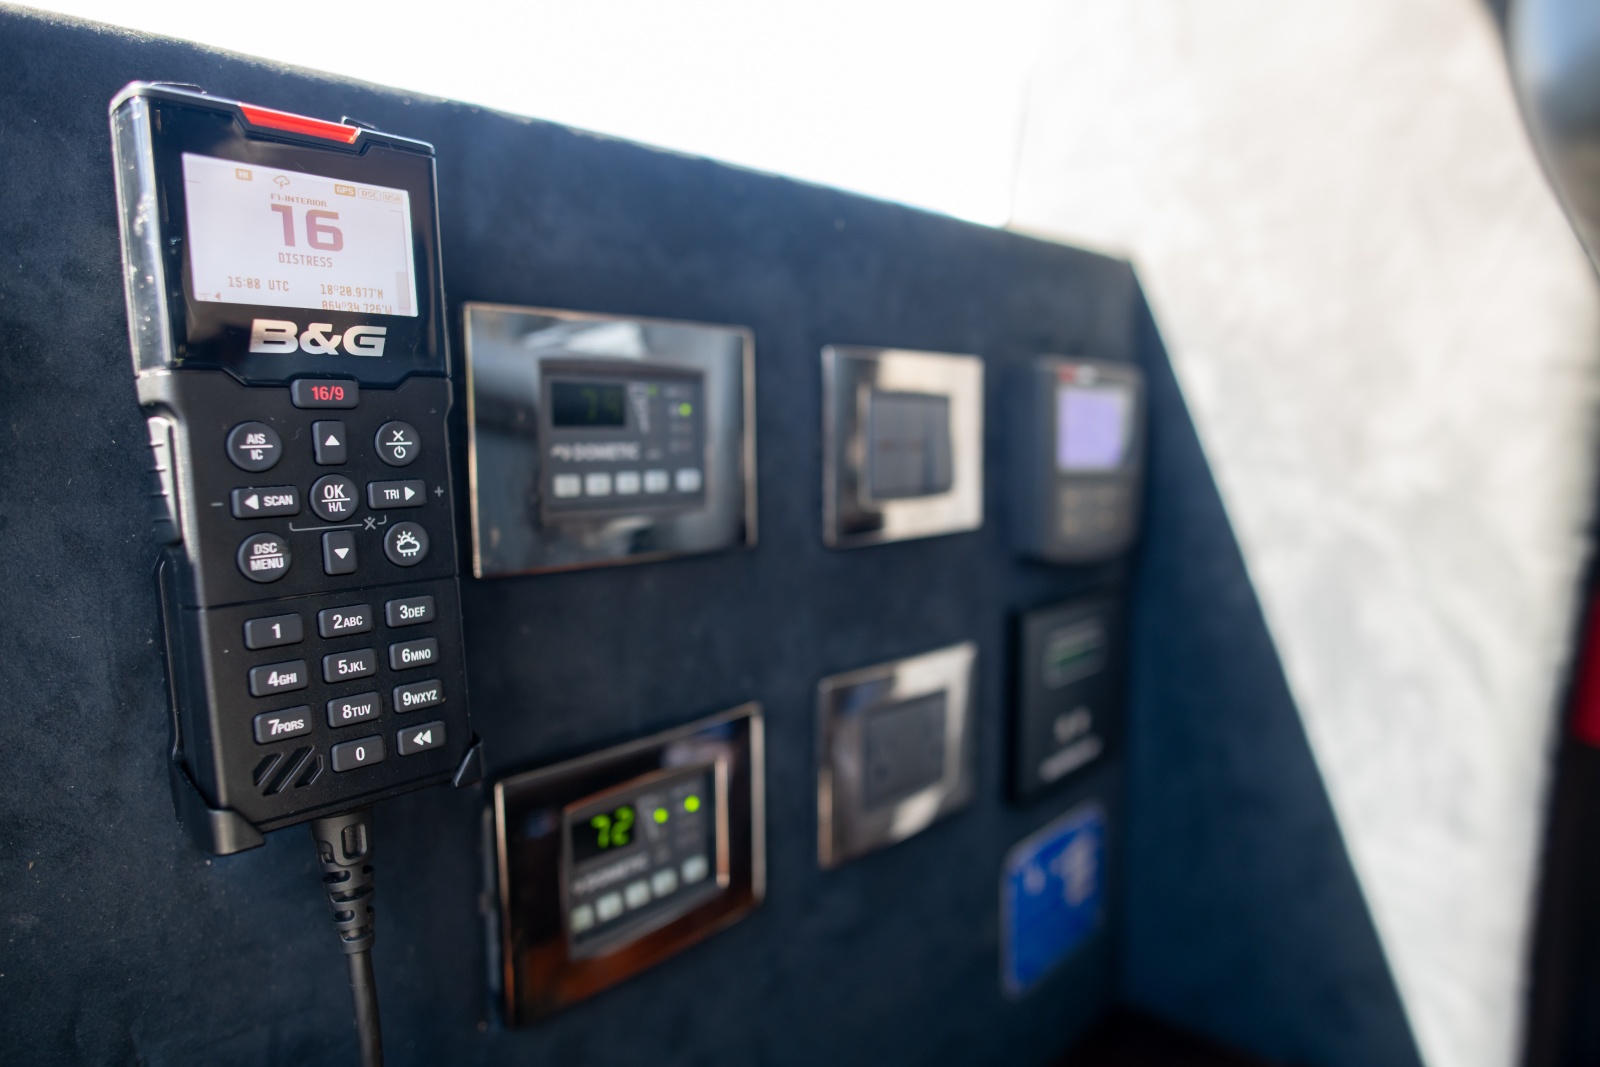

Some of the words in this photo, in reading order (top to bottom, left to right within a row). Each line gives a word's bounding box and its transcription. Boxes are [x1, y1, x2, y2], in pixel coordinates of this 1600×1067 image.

[238, 171, 249, 179] HI
[336, 186, 354, 195] GPS
[361, 190, 378, 198] DSC
[270, 193, 327, 208] F1-INTERIOR
[270, 203, 344, 252] 16
[278, 252, 333, 268] DISTRESS
[268, 279, 290, 292] UTC
[321, 300, 393, 315] 064°34726'W
[249, 318, 387, 357] B&G
[311, 386, 344, 401] 16/9
[246, 433, 266, 445] AIS
[250, 449, 263, 460] IC
[323, 484, 345, 499] OK
[384, 489, 400, 500] TRI
[263, 495, 293, 507] SCAN
[328, 502, 346, 512] H/L
[253, 543, 277, 554] DSC
[250, 557, 284, 571] MENU
[399, 605, 426, 619] 3DEF
[332, 614, 363, 630] 2ABC
[271, 623, 282, 639] 1
[401, 648, 431, 663] 6MNO
[338, 659, 366, 675] 5JKL
[267, 671, 298, 687] 4GHI
[402, 689, 438, 706] 9WXYZ
[342, 704, 371, 719] 8TUV
[355, 747, 365, 761] 0
[590, 806, 635, 849] 72
